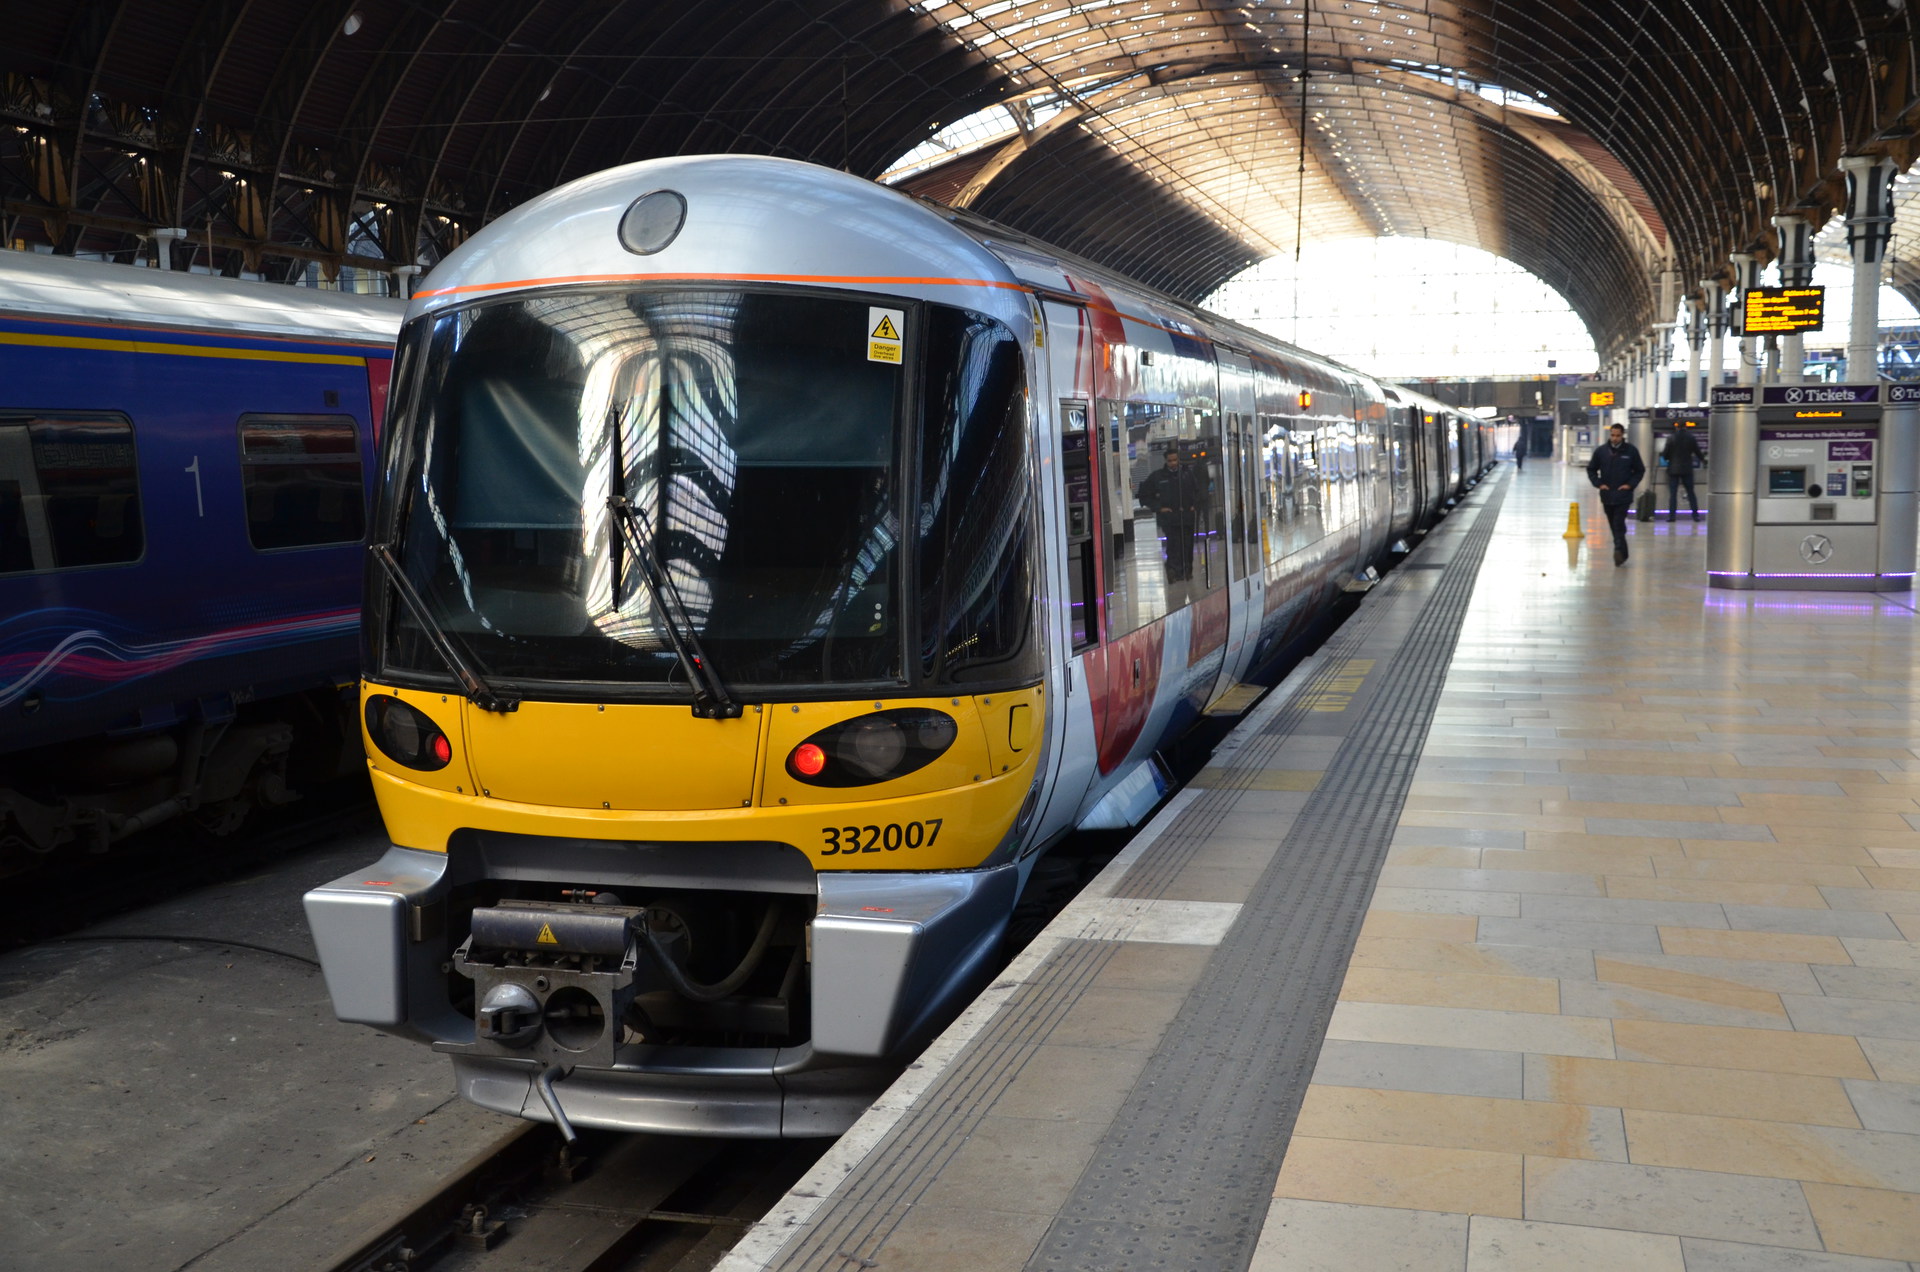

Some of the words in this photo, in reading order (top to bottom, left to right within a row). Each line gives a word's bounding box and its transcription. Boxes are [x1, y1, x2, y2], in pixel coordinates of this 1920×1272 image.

[1717, 391, 1751, 401] Tickets
[1805, 389, 1855, 401] Tickets
[184, 455, 204, 517] 1
[821, 818, 943, 855] 332007
